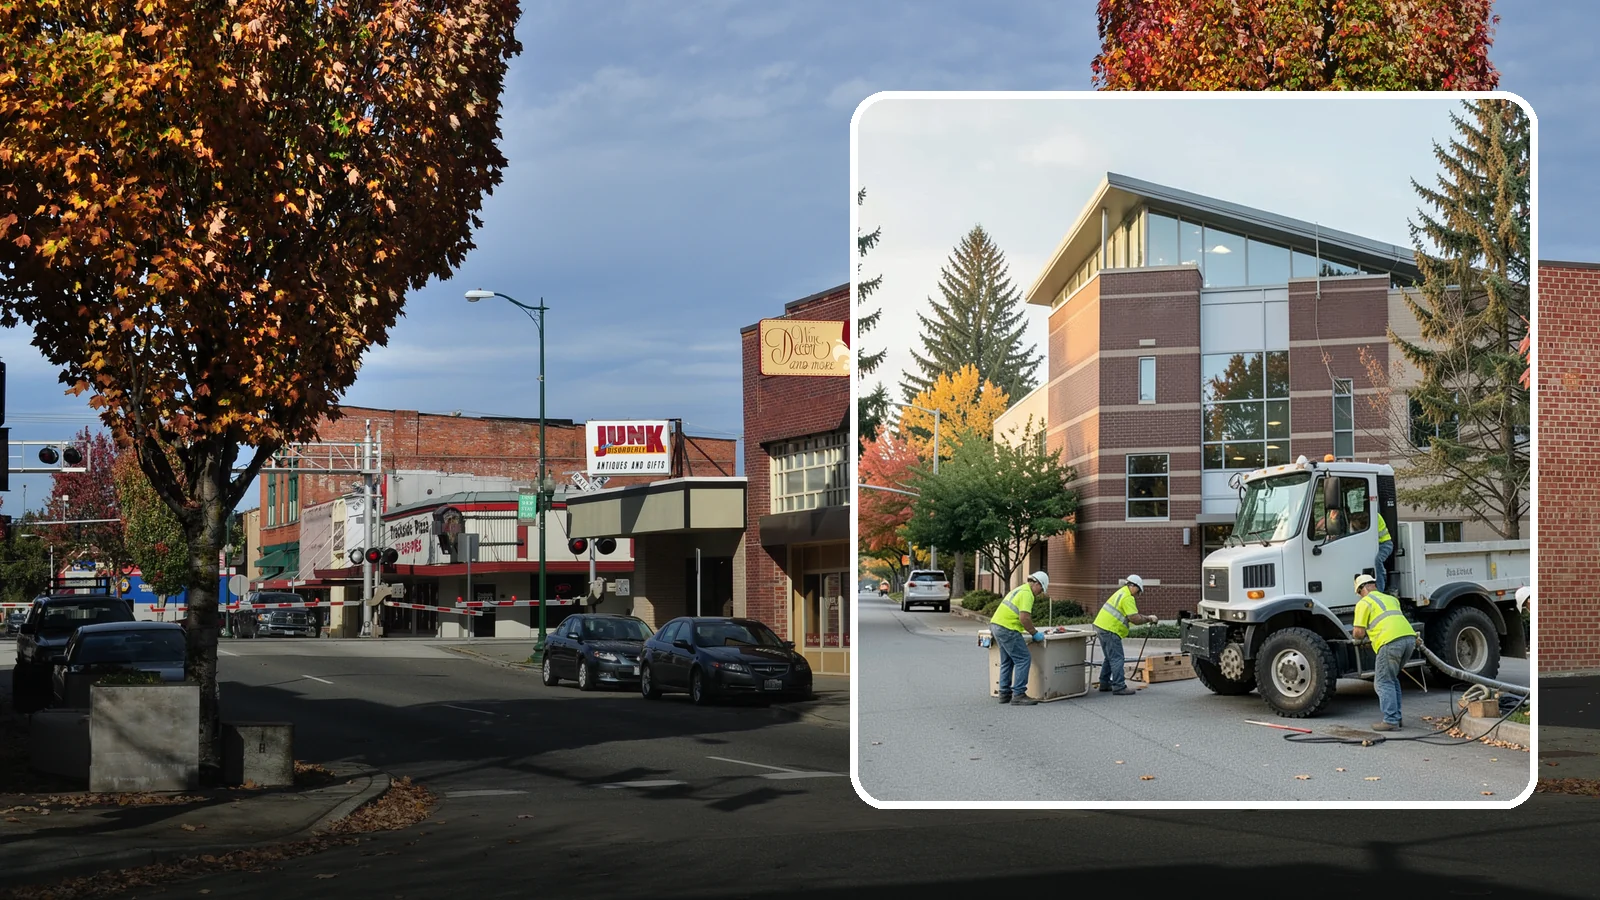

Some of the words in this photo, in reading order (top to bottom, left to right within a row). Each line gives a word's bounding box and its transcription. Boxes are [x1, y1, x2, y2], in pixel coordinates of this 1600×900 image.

[595, 425, 665, 457] JUNK
[597, 461, 628, 470] ANTIQUES
[631, 461, 643, 470] AND
[647, 461, 665, 469] GIFTS
[390, 521, 413, 539] Trackside
[414, 519, 429, 534] Pizza
